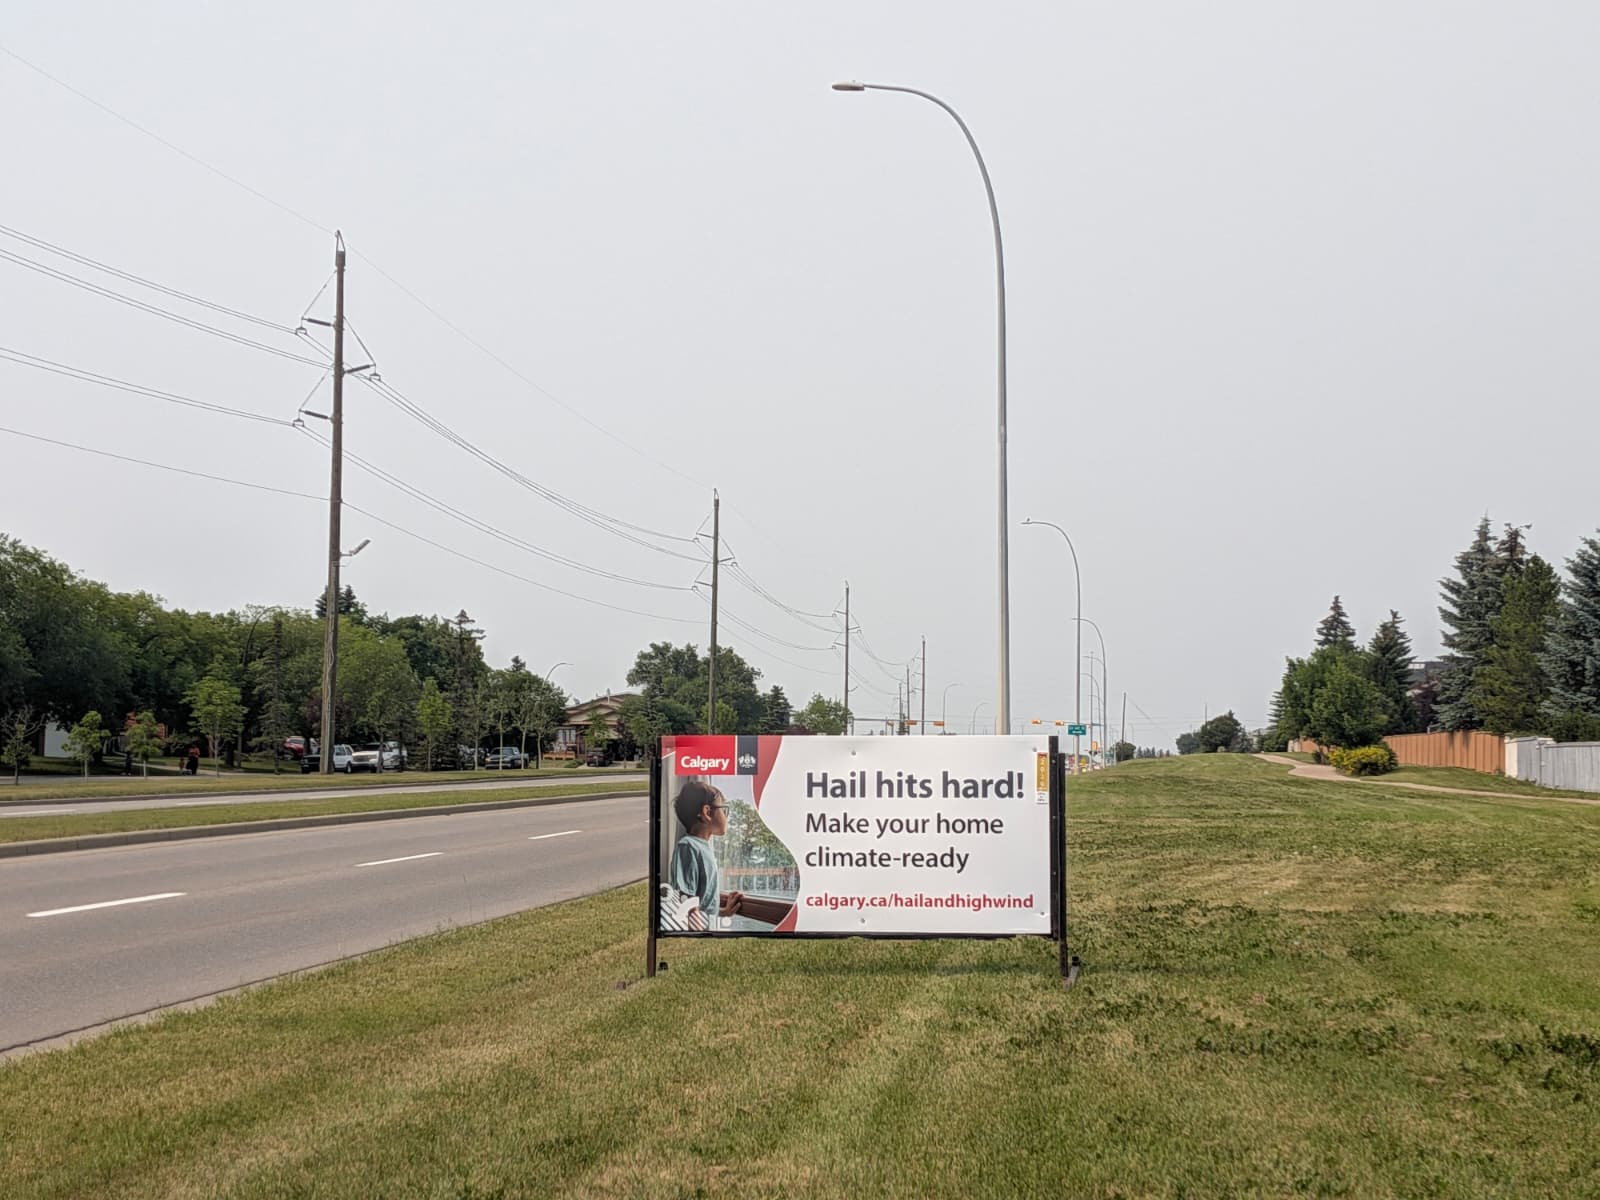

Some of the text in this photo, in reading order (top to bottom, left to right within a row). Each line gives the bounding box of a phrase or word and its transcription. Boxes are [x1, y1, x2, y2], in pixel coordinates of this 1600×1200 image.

[680, 755, 730, 771] Calgary
[806, 771, 866, 799] Hail
[876, 770, 933, 799] hits
[942, 770, 1024, 799] hard!
[806, 812, 1004, 839] Make your home
[805, 846, 970, 874] climate-ready
[806, 893, 1034, 911] calgary.ca/hailandhighwind
